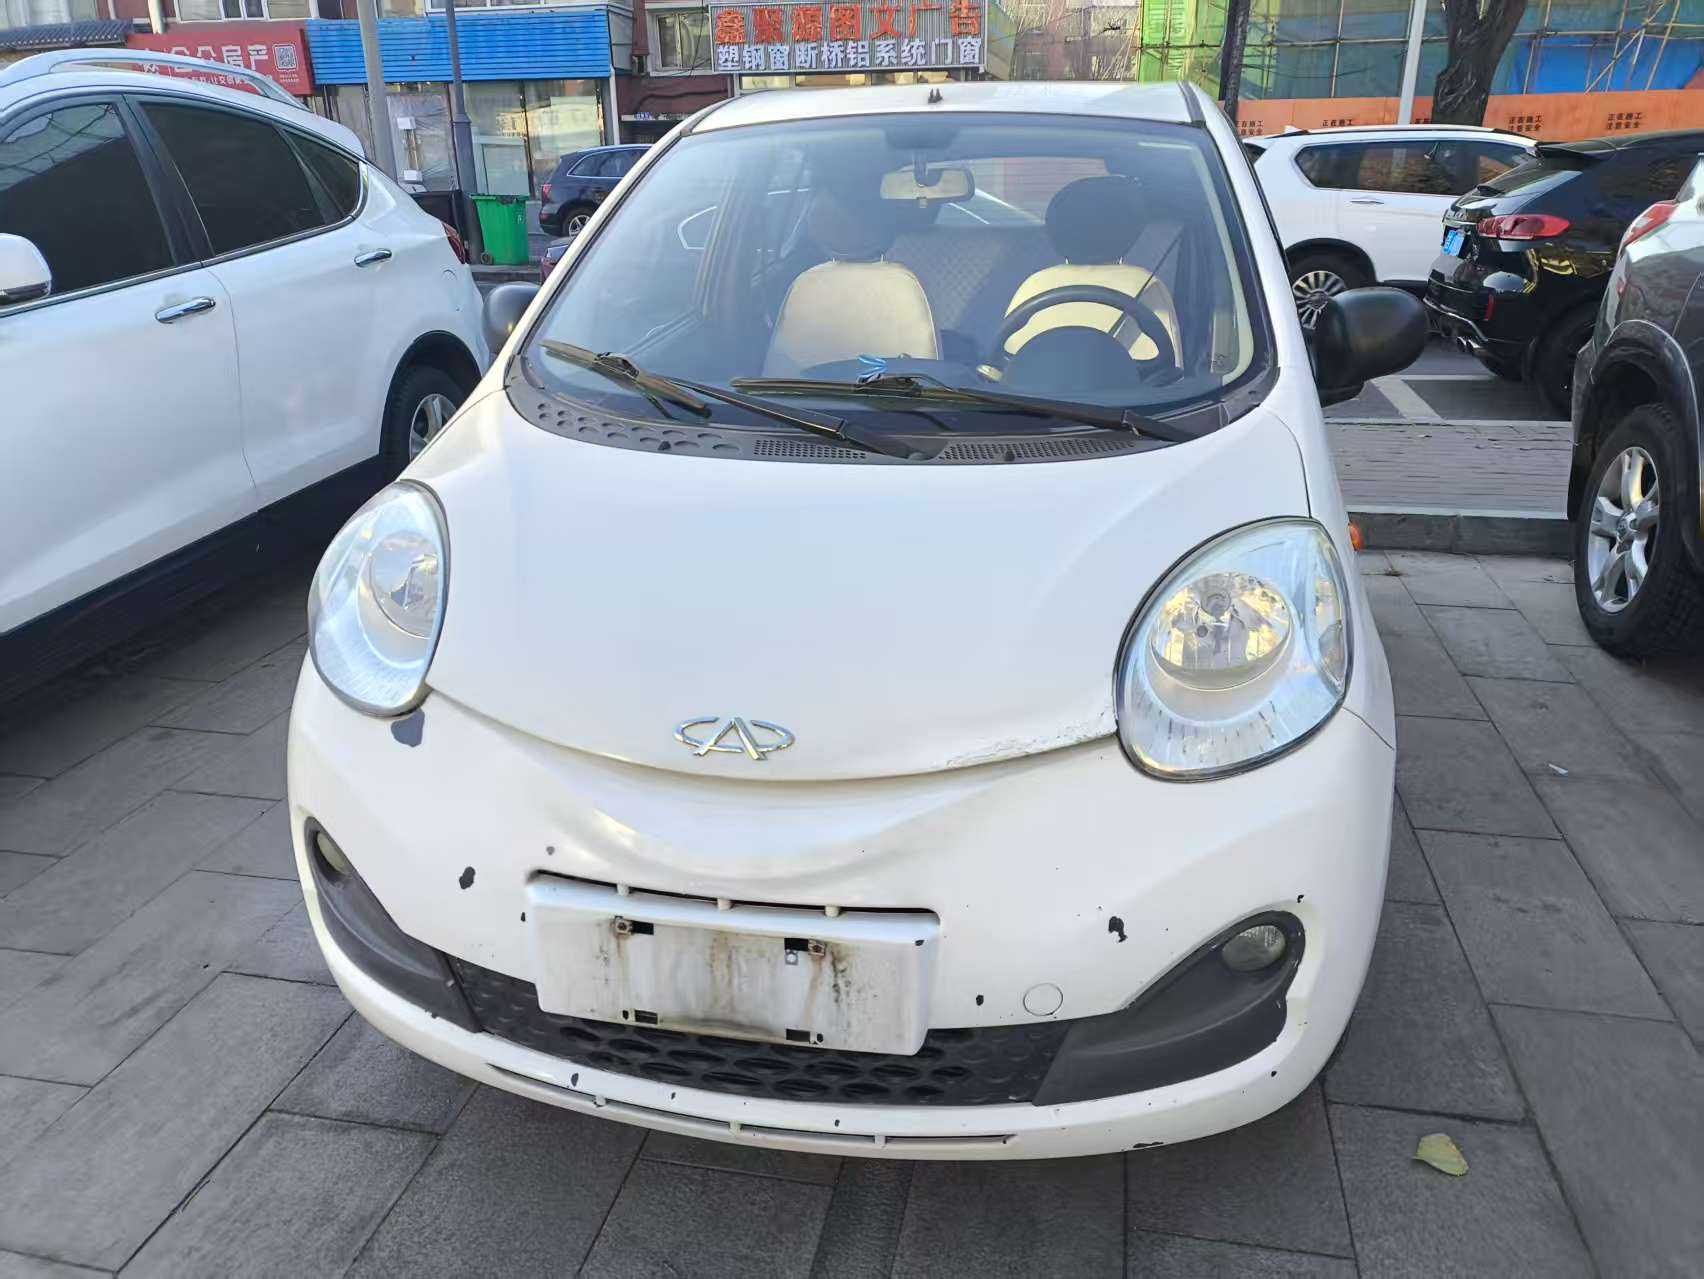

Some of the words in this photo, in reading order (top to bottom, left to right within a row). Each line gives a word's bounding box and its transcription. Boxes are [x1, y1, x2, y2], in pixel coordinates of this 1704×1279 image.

[717, 36, 982, 70] 塑钢窗断桥铝系统门窗
